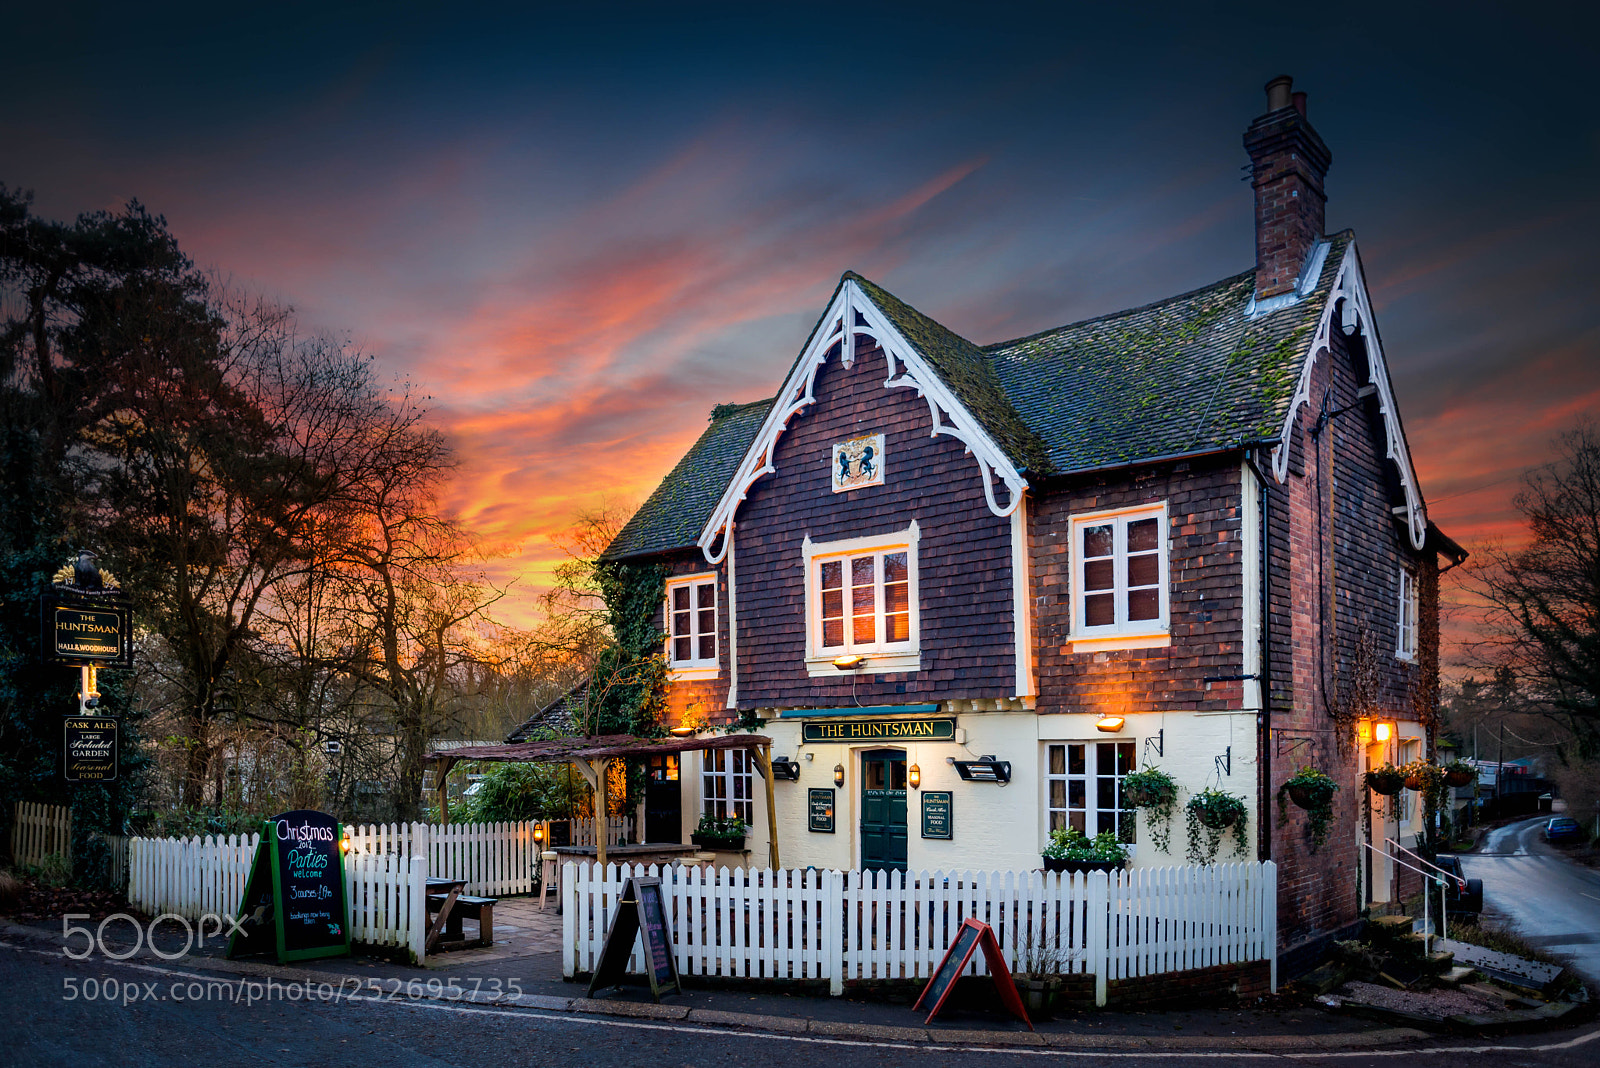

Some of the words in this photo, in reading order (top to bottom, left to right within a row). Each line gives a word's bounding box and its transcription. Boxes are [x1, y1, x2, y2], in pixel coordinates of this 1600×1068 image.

[80, 614, 96, 622] THE
[55, 621, 119, 634] HUNTSMAN
[66, 721, 89, 729] CASK
[819, 725, 844, 737] THE
[851, 722, 934, 737] HUNTSMAN
[69, 740, 113, 749] Secluded
[276, 819, 334, 841] Christmas
[287, 849, 328, 870] Parties
[293, 869, 323, 878] welcome
[290, 885, 297, 899] 3
